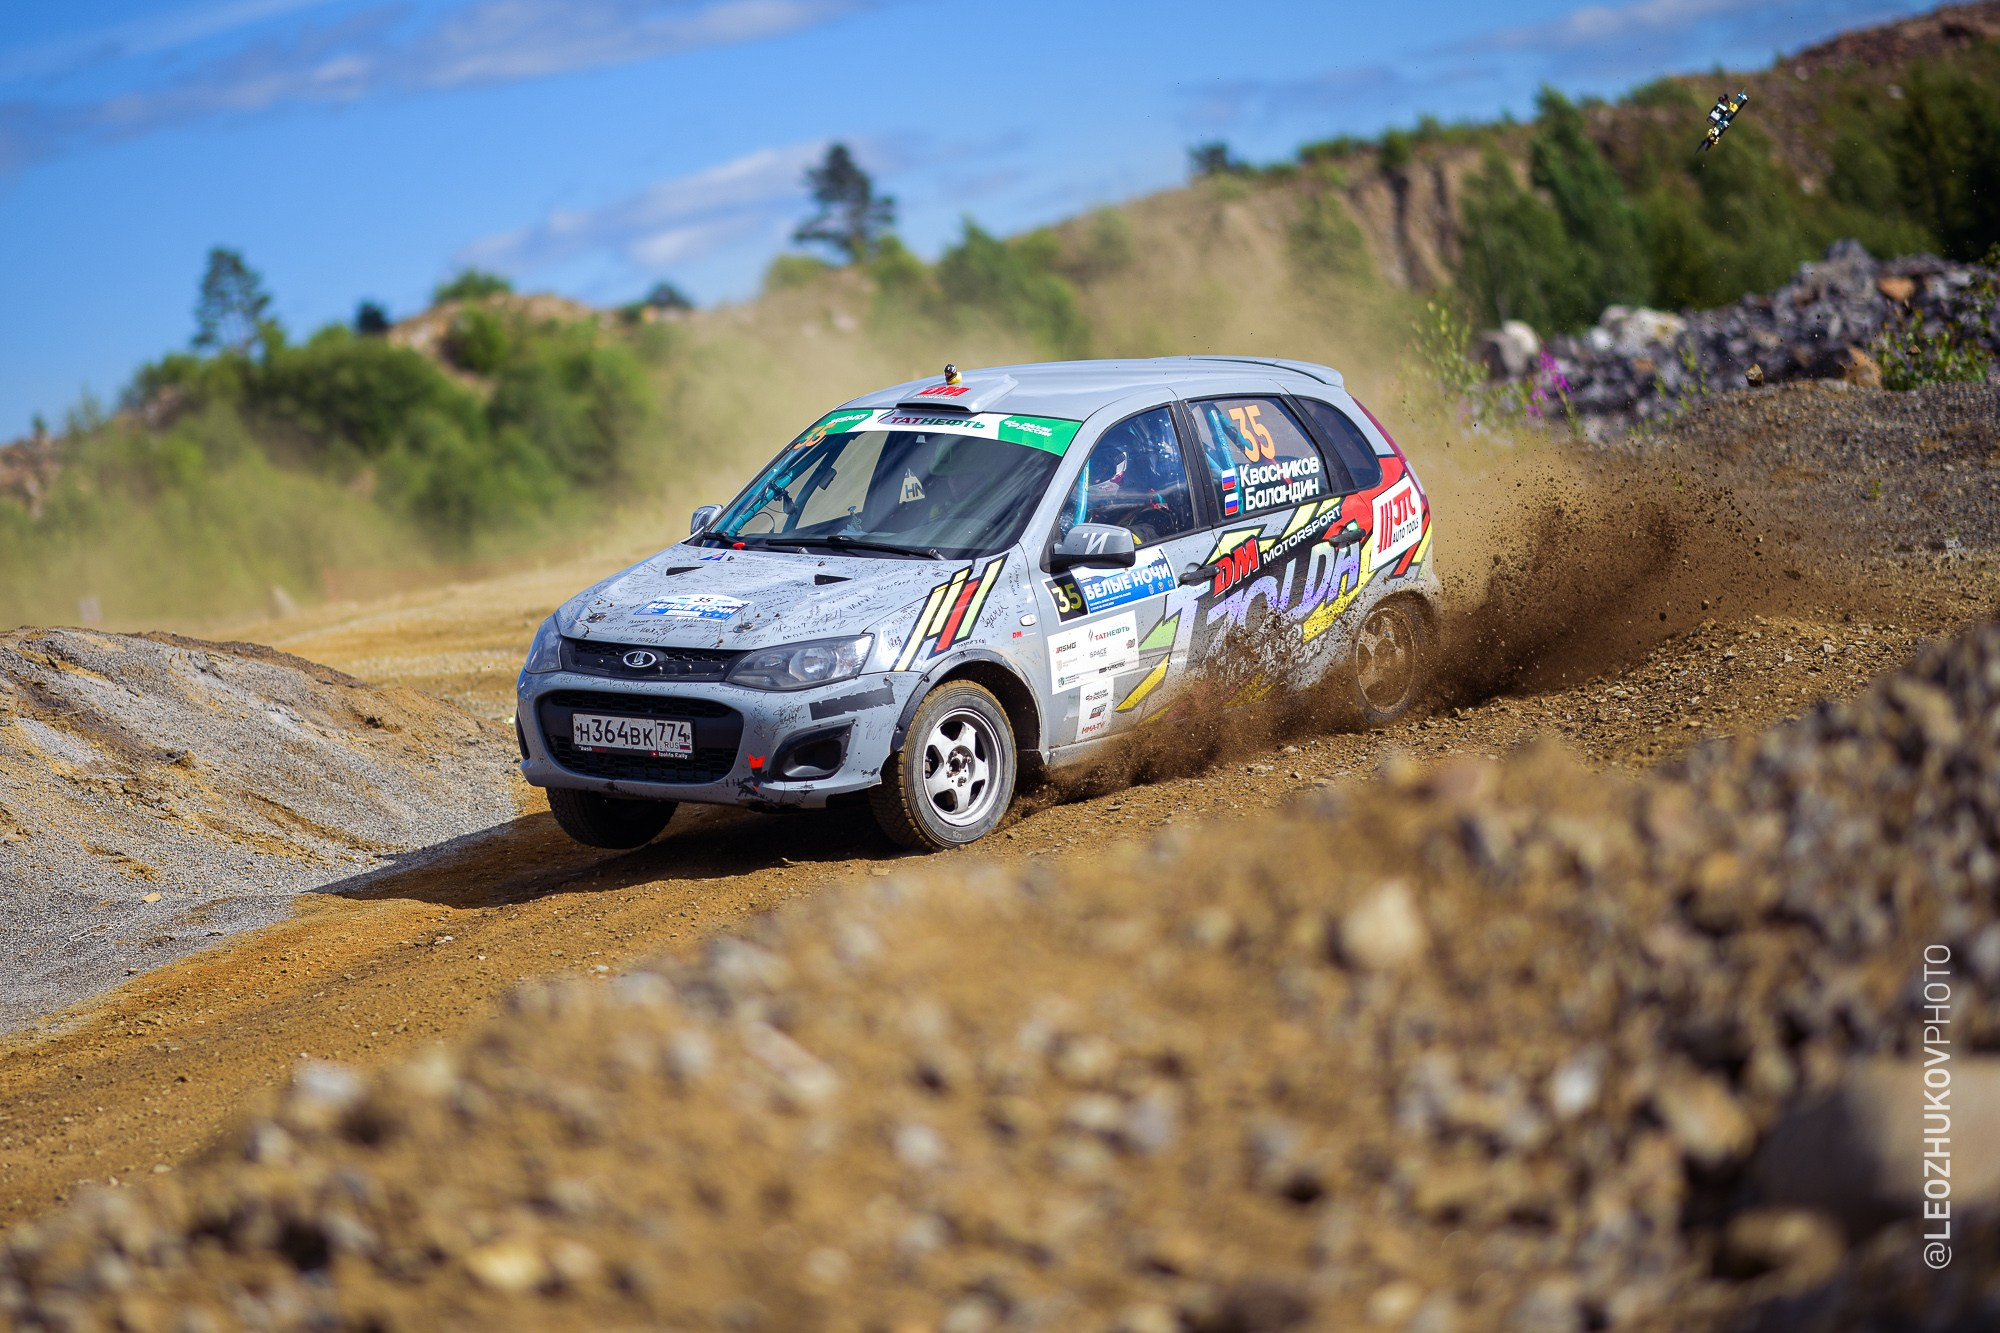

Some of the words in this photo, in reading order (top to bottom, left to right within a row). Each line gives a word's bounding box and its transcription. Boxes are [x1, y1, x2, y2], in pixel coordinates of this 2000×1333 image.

[793, 423, 836, 449] 35
[889, 416, 986, 429] ТАТНЕФТЬ
[1228, 404, 1276, 463] 35
[1239, 456, 1320, 488] Квасников
[1245, 478, 1320, 511] Баландин
[1263, 505, 1342, 565] MOTORSPORT
[1083, 575, 1132, 601] БЕЛЫЕ
[1131, 562, 1171, 588] НОЧИ
[1213, 537, 1260, 598] DM
[1051, 583, 1082, 614] 35
[1094, 625, 1130, 641] ТАТНЕФТЬ
[656, 721, 688, 743] 774
[664, 741, 680, 750] RUS
